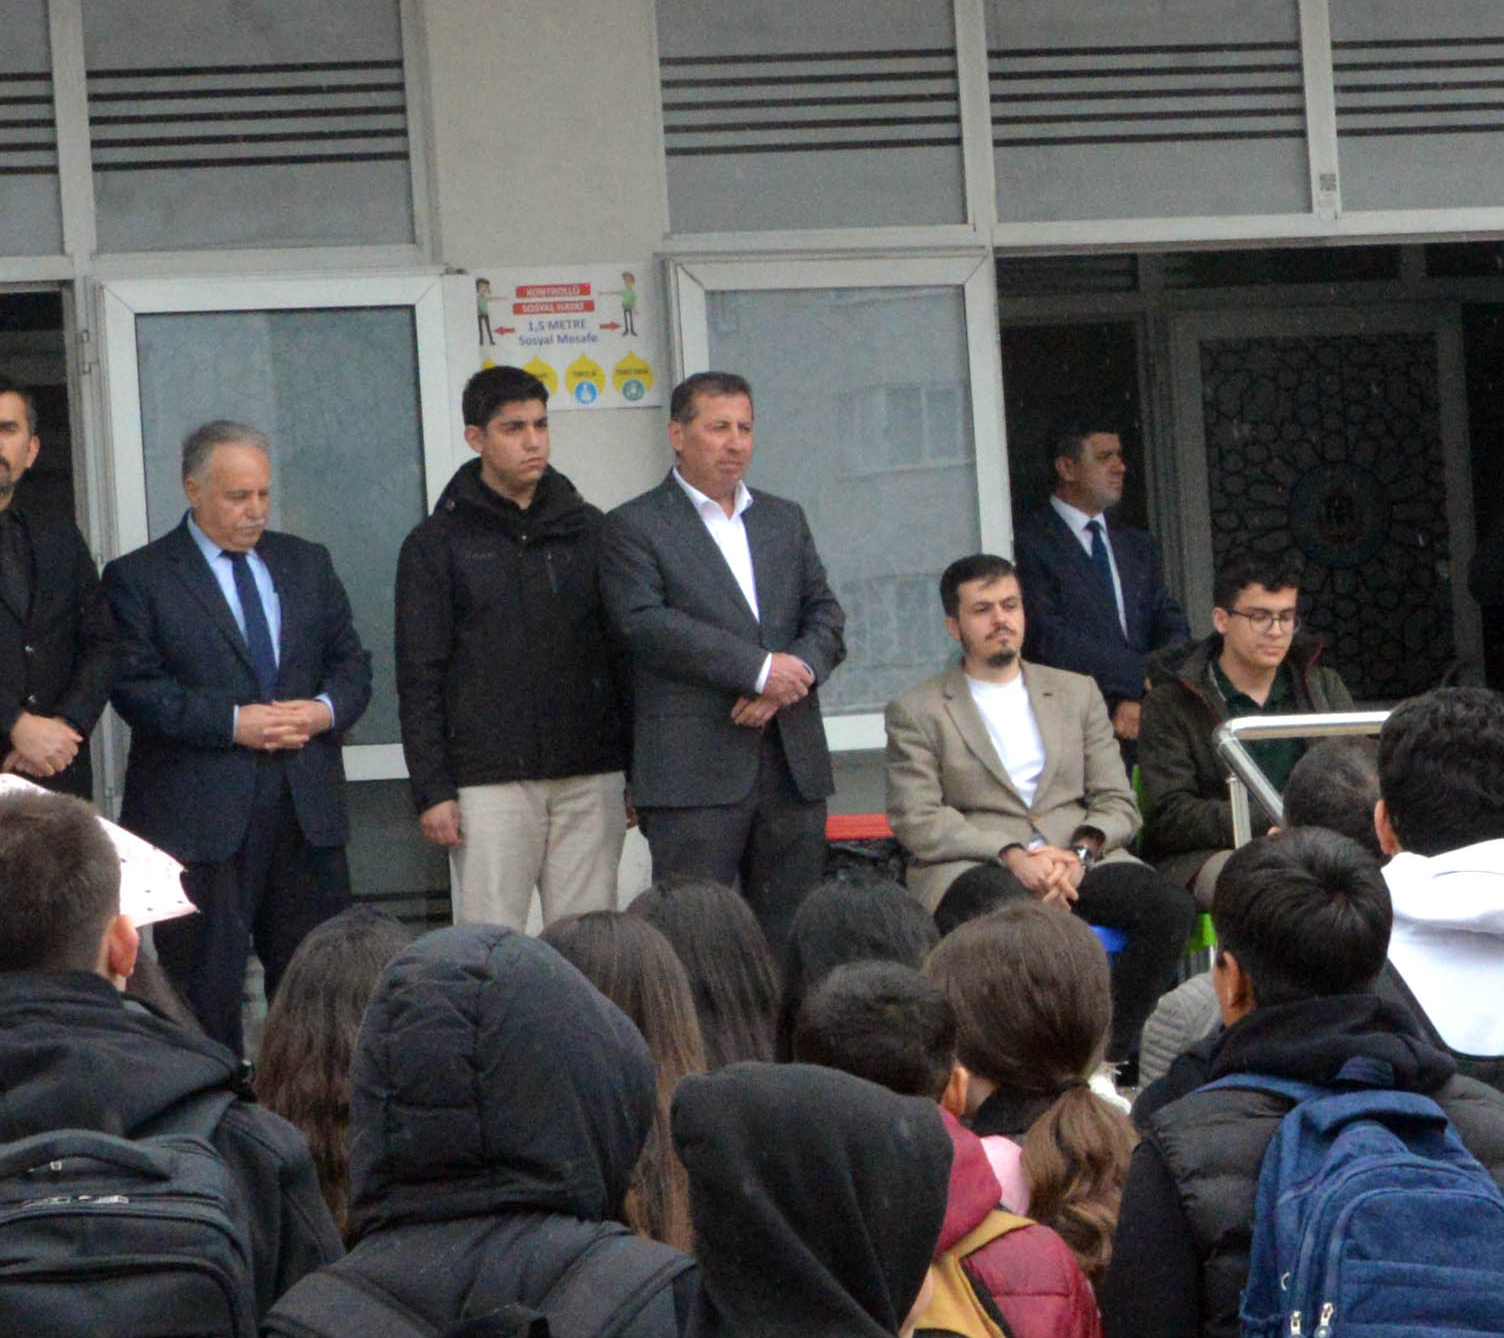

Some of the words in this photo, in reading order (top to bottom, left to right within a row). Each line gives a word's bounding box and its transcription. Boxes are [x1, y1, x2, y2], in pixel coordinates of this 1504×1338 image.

[547, 319, 587, 331] METRE
[518, 334, 553, 347] Sosyal
[556, 332, 598, 344] Mesafe
